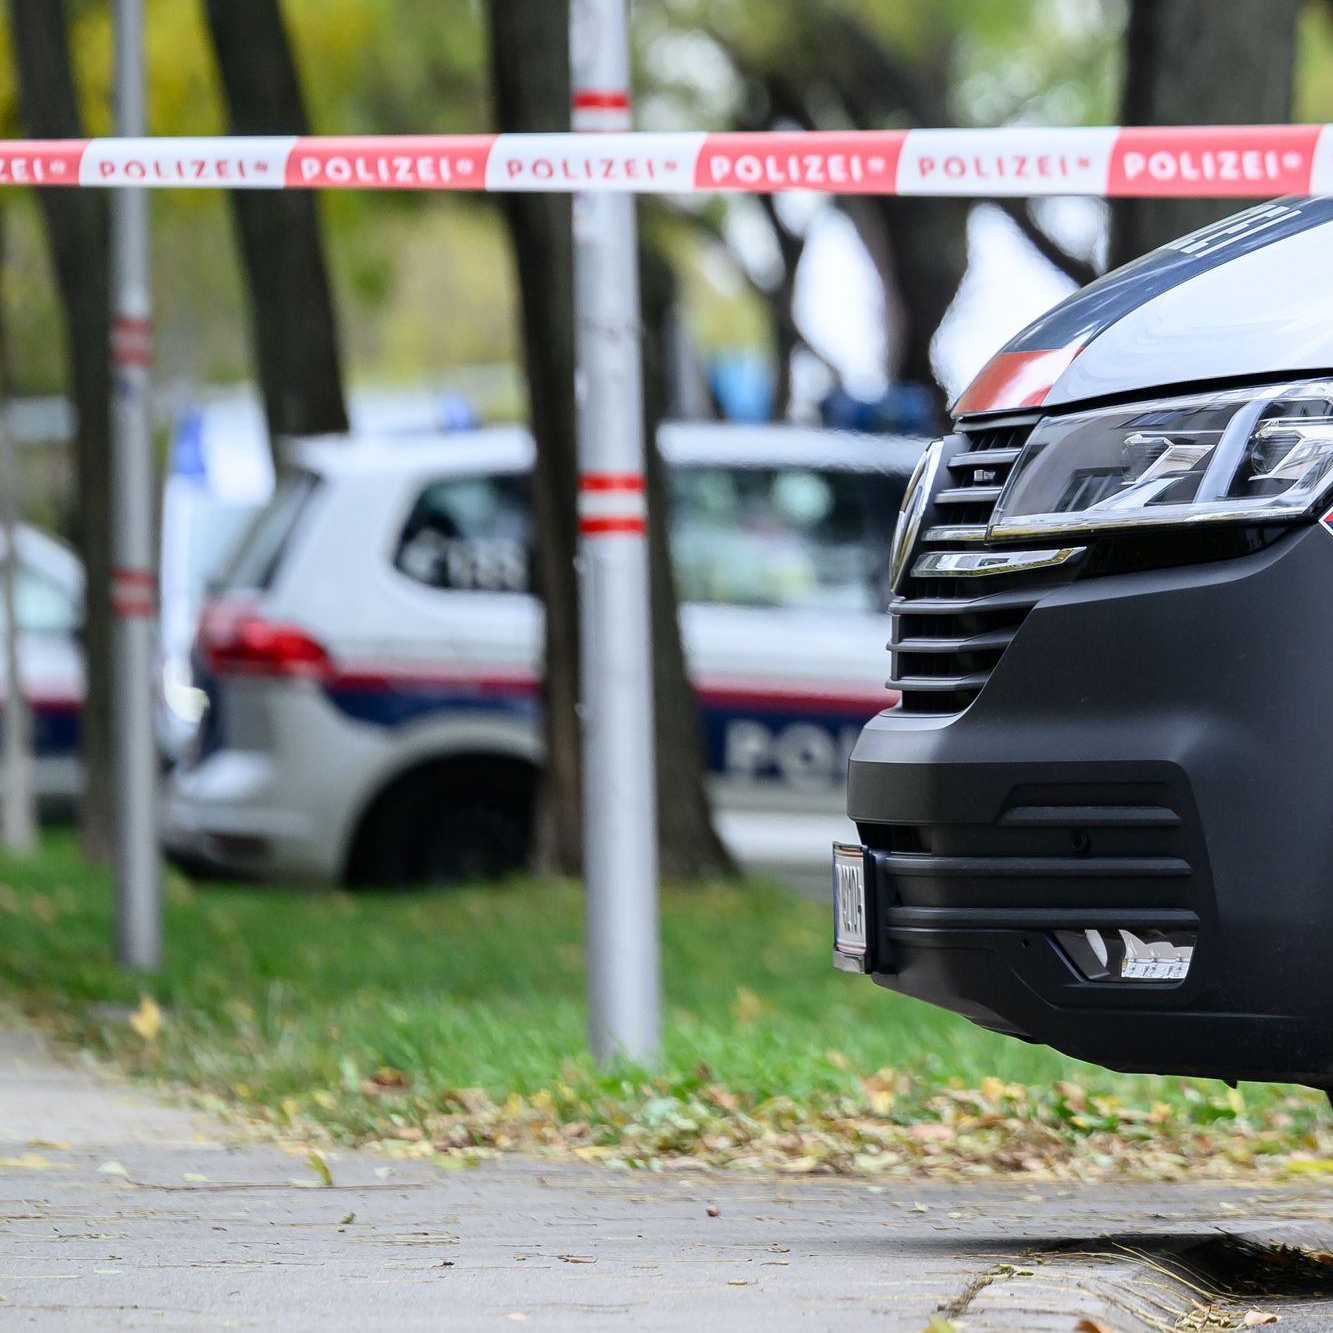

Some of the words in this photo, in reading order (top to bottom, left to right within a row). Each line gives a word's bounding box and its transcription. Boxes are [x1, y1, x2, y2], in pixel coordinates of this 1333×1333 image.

[101, 160, 245, 179] POLIZEI
[301, 156, 450, 182] POLIZEI
[507, 157, 655, 179] POLIZEI
[710, 154, 863, 183] POLIZEI
[918, 155, 1068, 179] POLIZEI
[1123, 150, 1277, 181] POLIZEI
